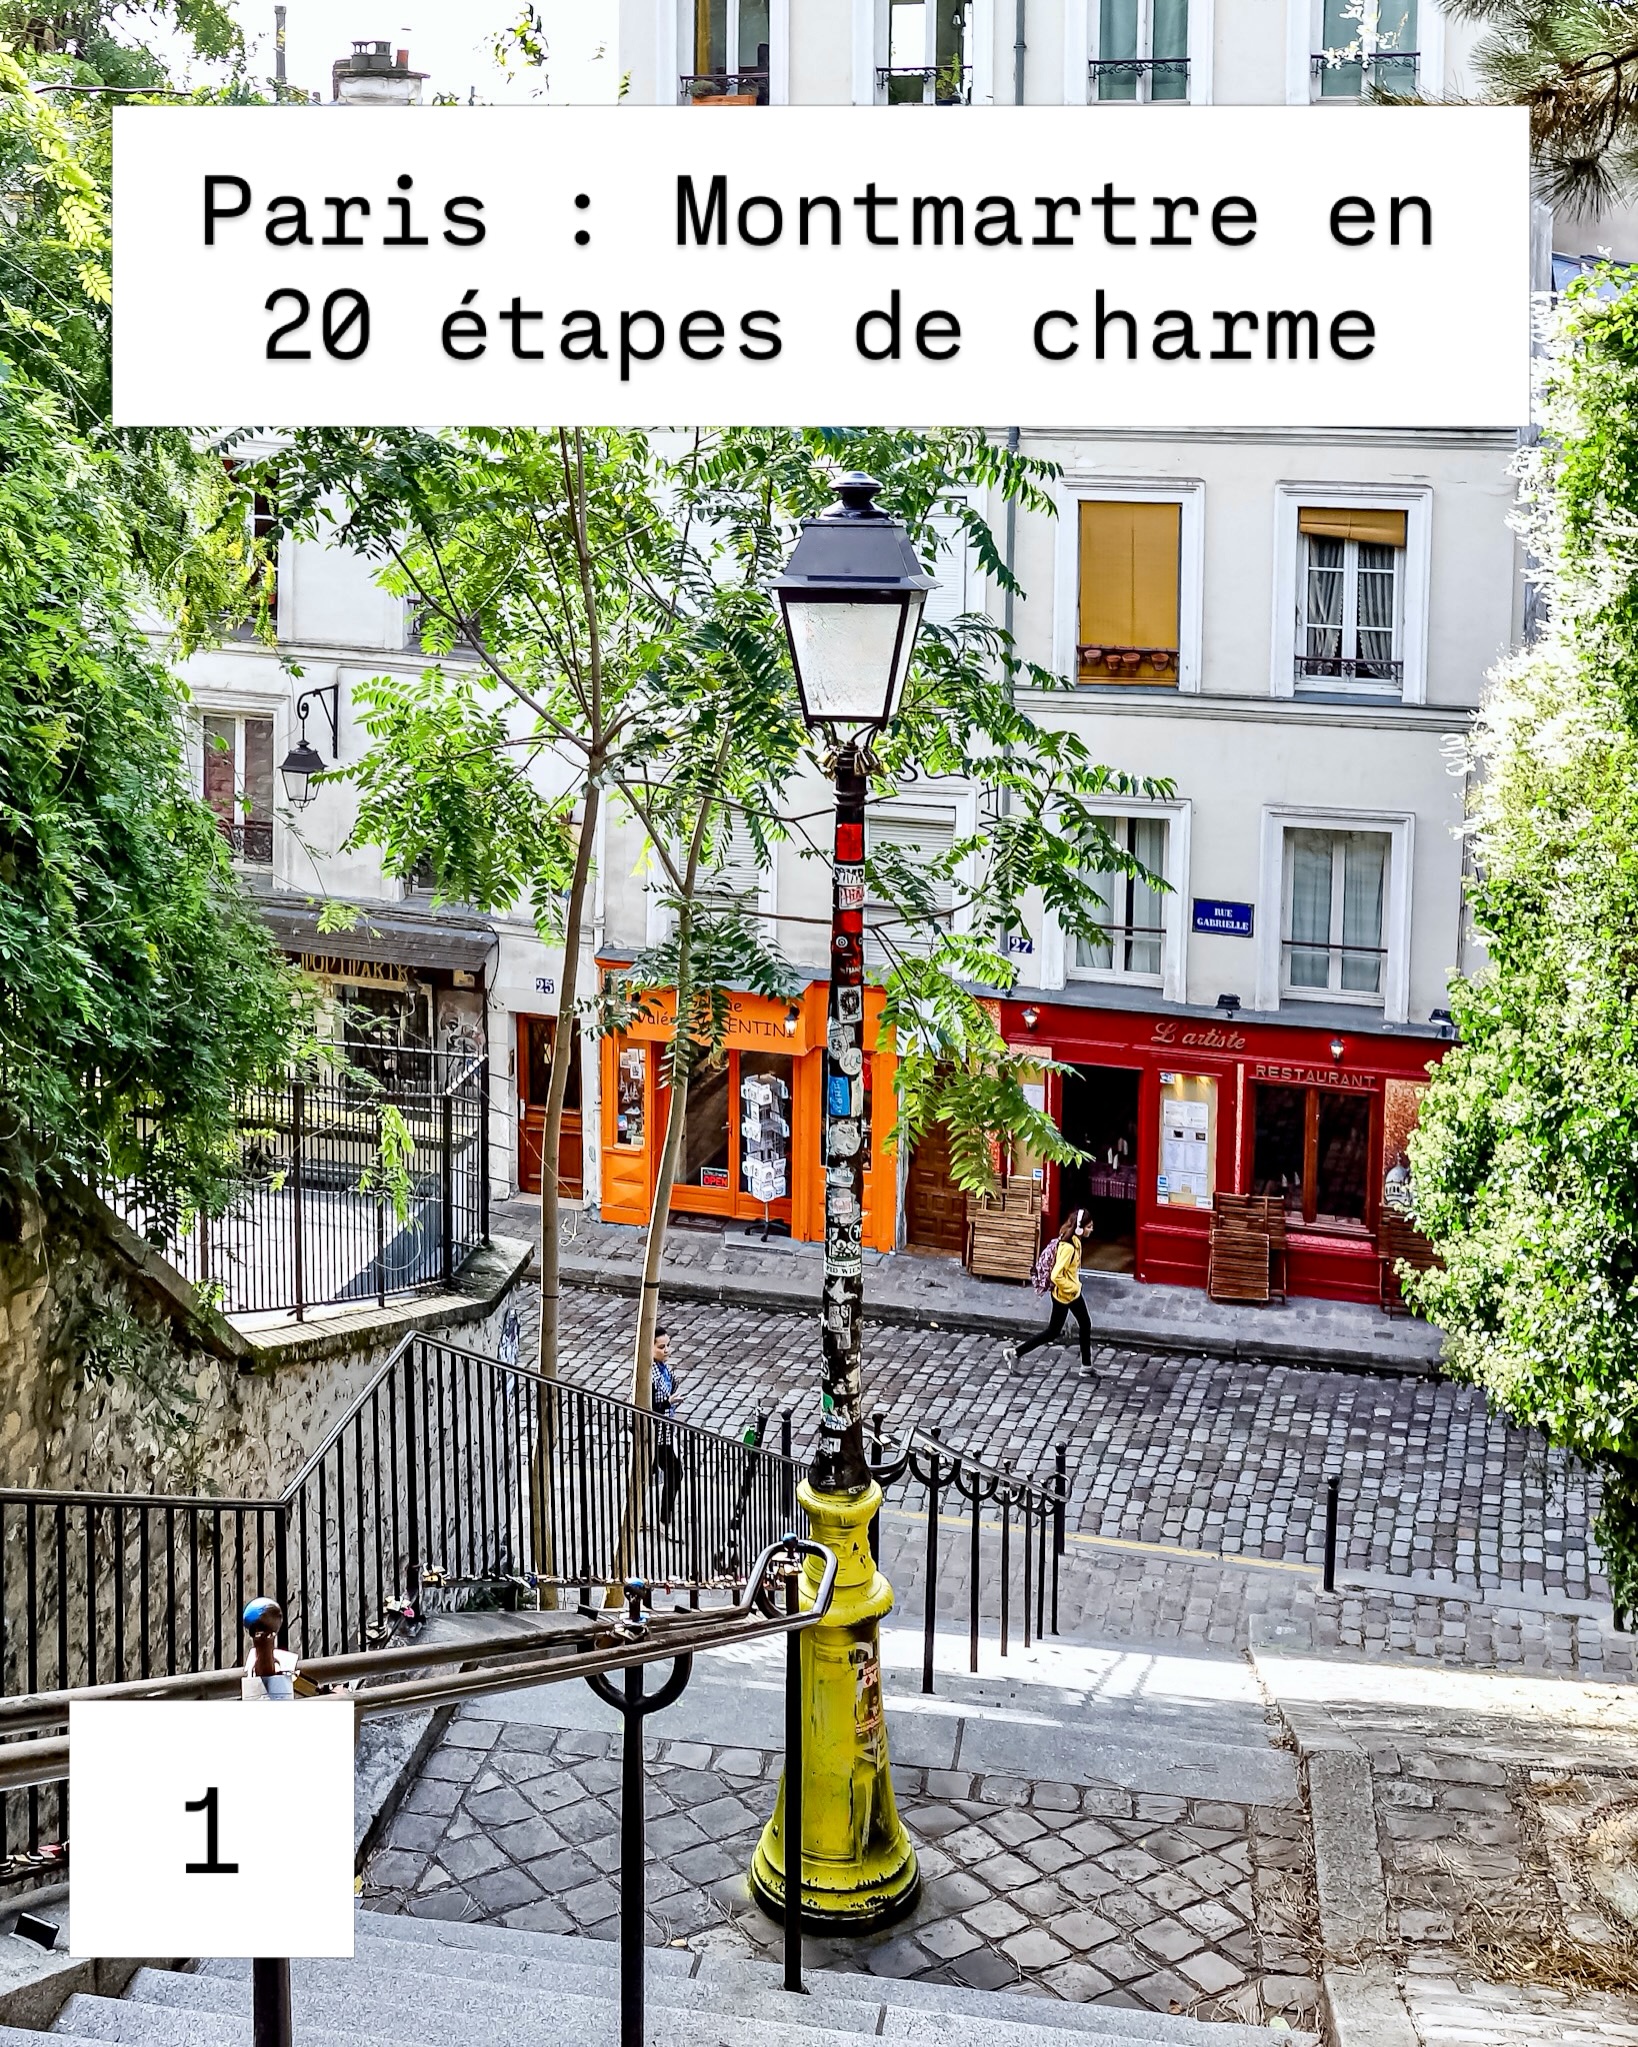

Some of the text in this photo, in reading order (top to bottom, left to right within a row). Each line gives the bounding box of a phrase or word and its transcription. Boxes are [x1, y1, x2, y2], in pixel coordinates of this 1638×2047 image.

[1214, 907, 1233, 918] RUE
[1196, 917, 1249, 931] GABRIELLE
[1010, 937, 1031, 952] 27
[536, 979, 553, 994] 25
[1256, 1064, 1376, 1089] RESTAURANT
[703, 1175, 727, 1187] OPEN
